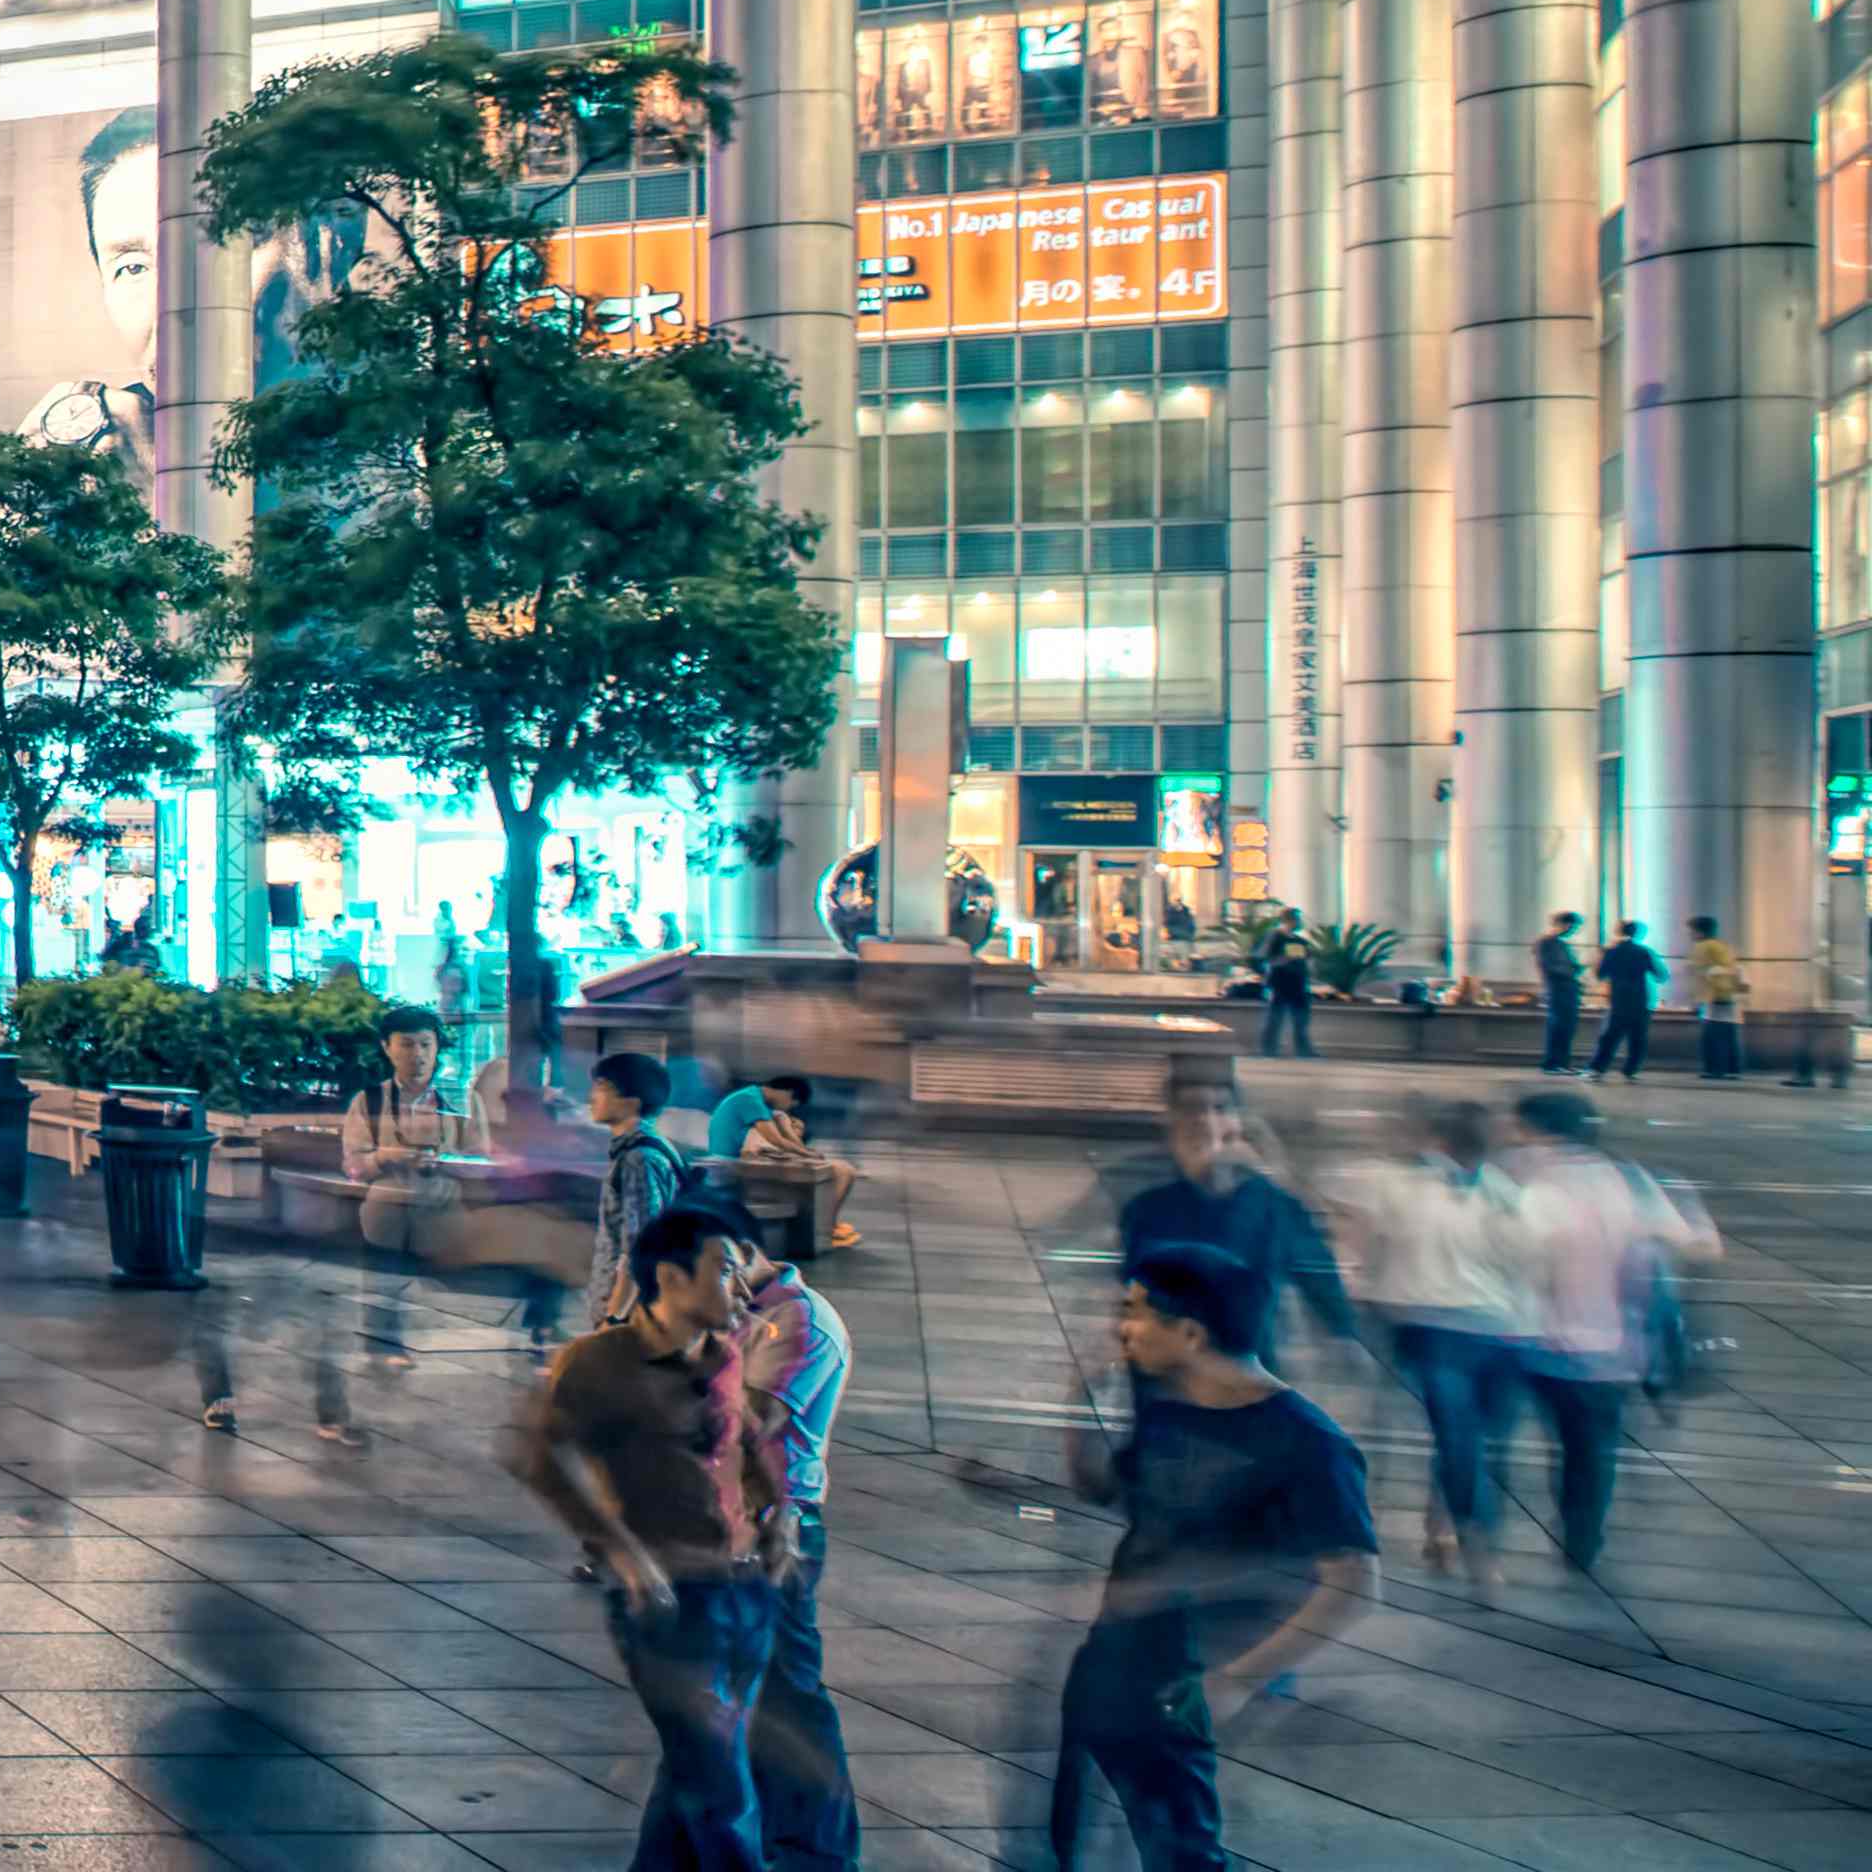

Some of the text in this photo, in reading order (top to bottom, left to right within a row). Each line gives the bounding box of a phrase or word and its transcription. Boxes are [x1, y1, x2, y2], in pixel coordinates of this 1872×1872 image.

[887, 190, 1205, 241] No.1 Japanese Casual
